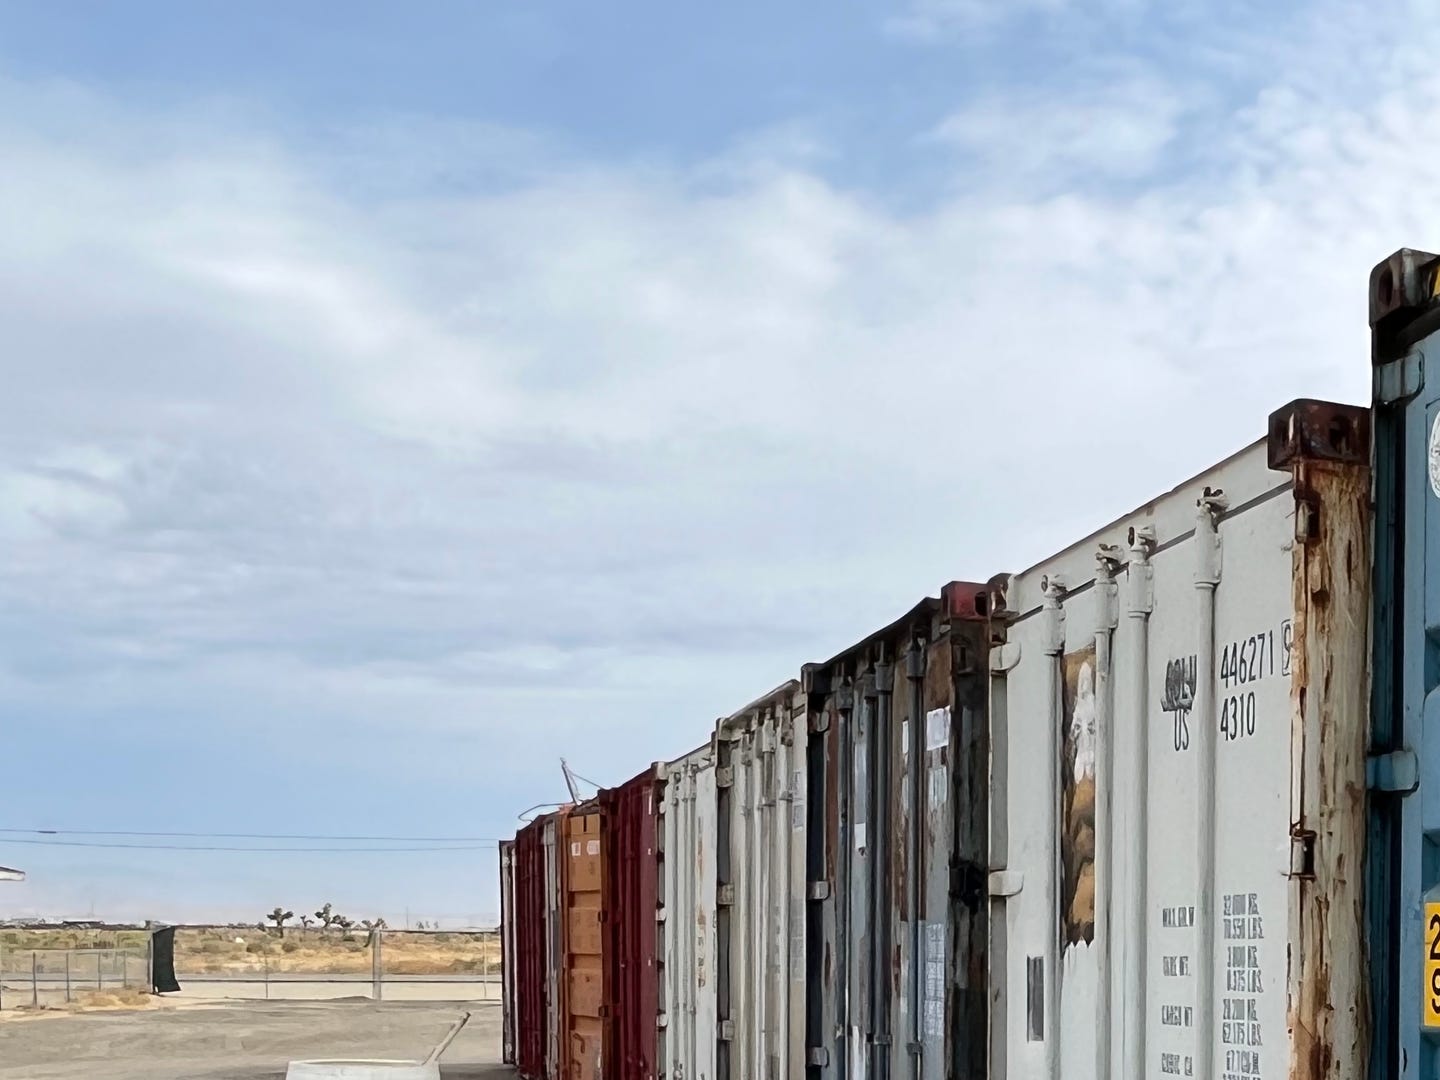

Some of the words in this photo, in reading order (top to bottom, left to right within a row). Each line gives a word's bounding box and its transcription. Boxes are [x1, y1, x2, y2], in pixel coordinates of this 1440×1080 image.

[1221, 629, 1274, 689] 446271
[1174, 708, 1189, 752] US
[1220, 691, 1255, 741] 4310
